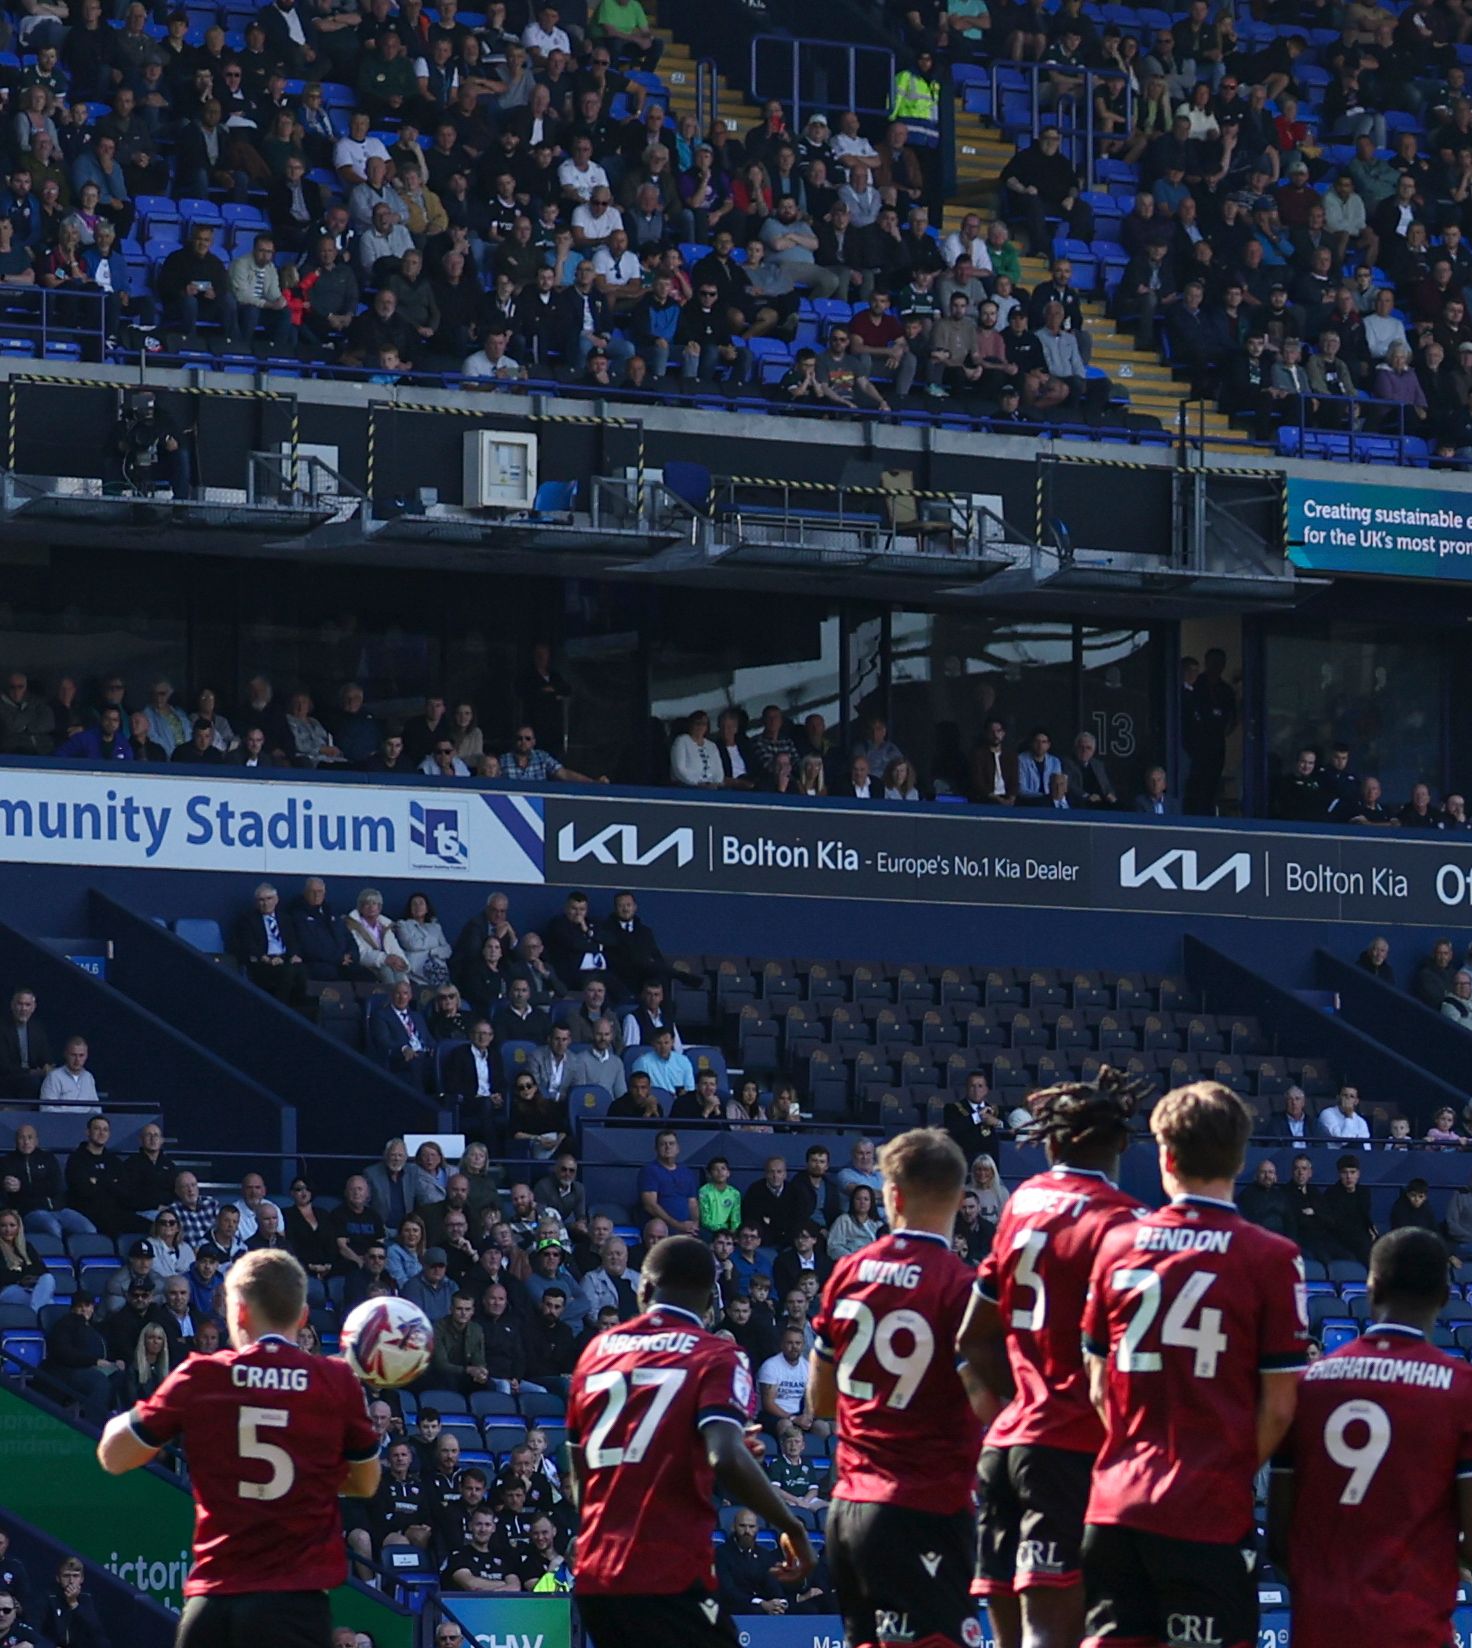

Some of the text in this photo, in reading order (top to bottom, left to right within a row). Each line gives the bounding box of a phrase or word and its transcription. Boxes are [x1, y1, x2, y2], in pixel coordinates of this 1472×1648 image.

[1304, 499, 1371, 525] Creating
[1375, 507, 1464, 530] sustainable
[1304, 526, 1327, 544] for
[1330, 528, 1356, 546] the
[1360, 530, 1393, 549] UK's
[1397, 535, 1436, 553] most
[186, 795, 396, 853] Stadium
[558, 821, 1079, 882] KIA Bolton Kia Europe's No.1 Kia Dealer
[1120, 846, 1408, 898] KIA Bolton Kia
[1135, 1227, 1231, 1254] BINDON
[858, 1258, 922, 1290] WING
[596, 1332, 699, 1358] MBENGUE
[1111, 1270, 1227, 1379] 24
[233, 1364, 308, 1392] CRAIG
[833, 1301, 935, 1409] 29
[584, 1368, 688, 1469] 27
[238, 1406, 295, 1500] 5
[1323, 1399, 1392, 1505] 9
[1167, 1611, 1222, 1645] CRL
